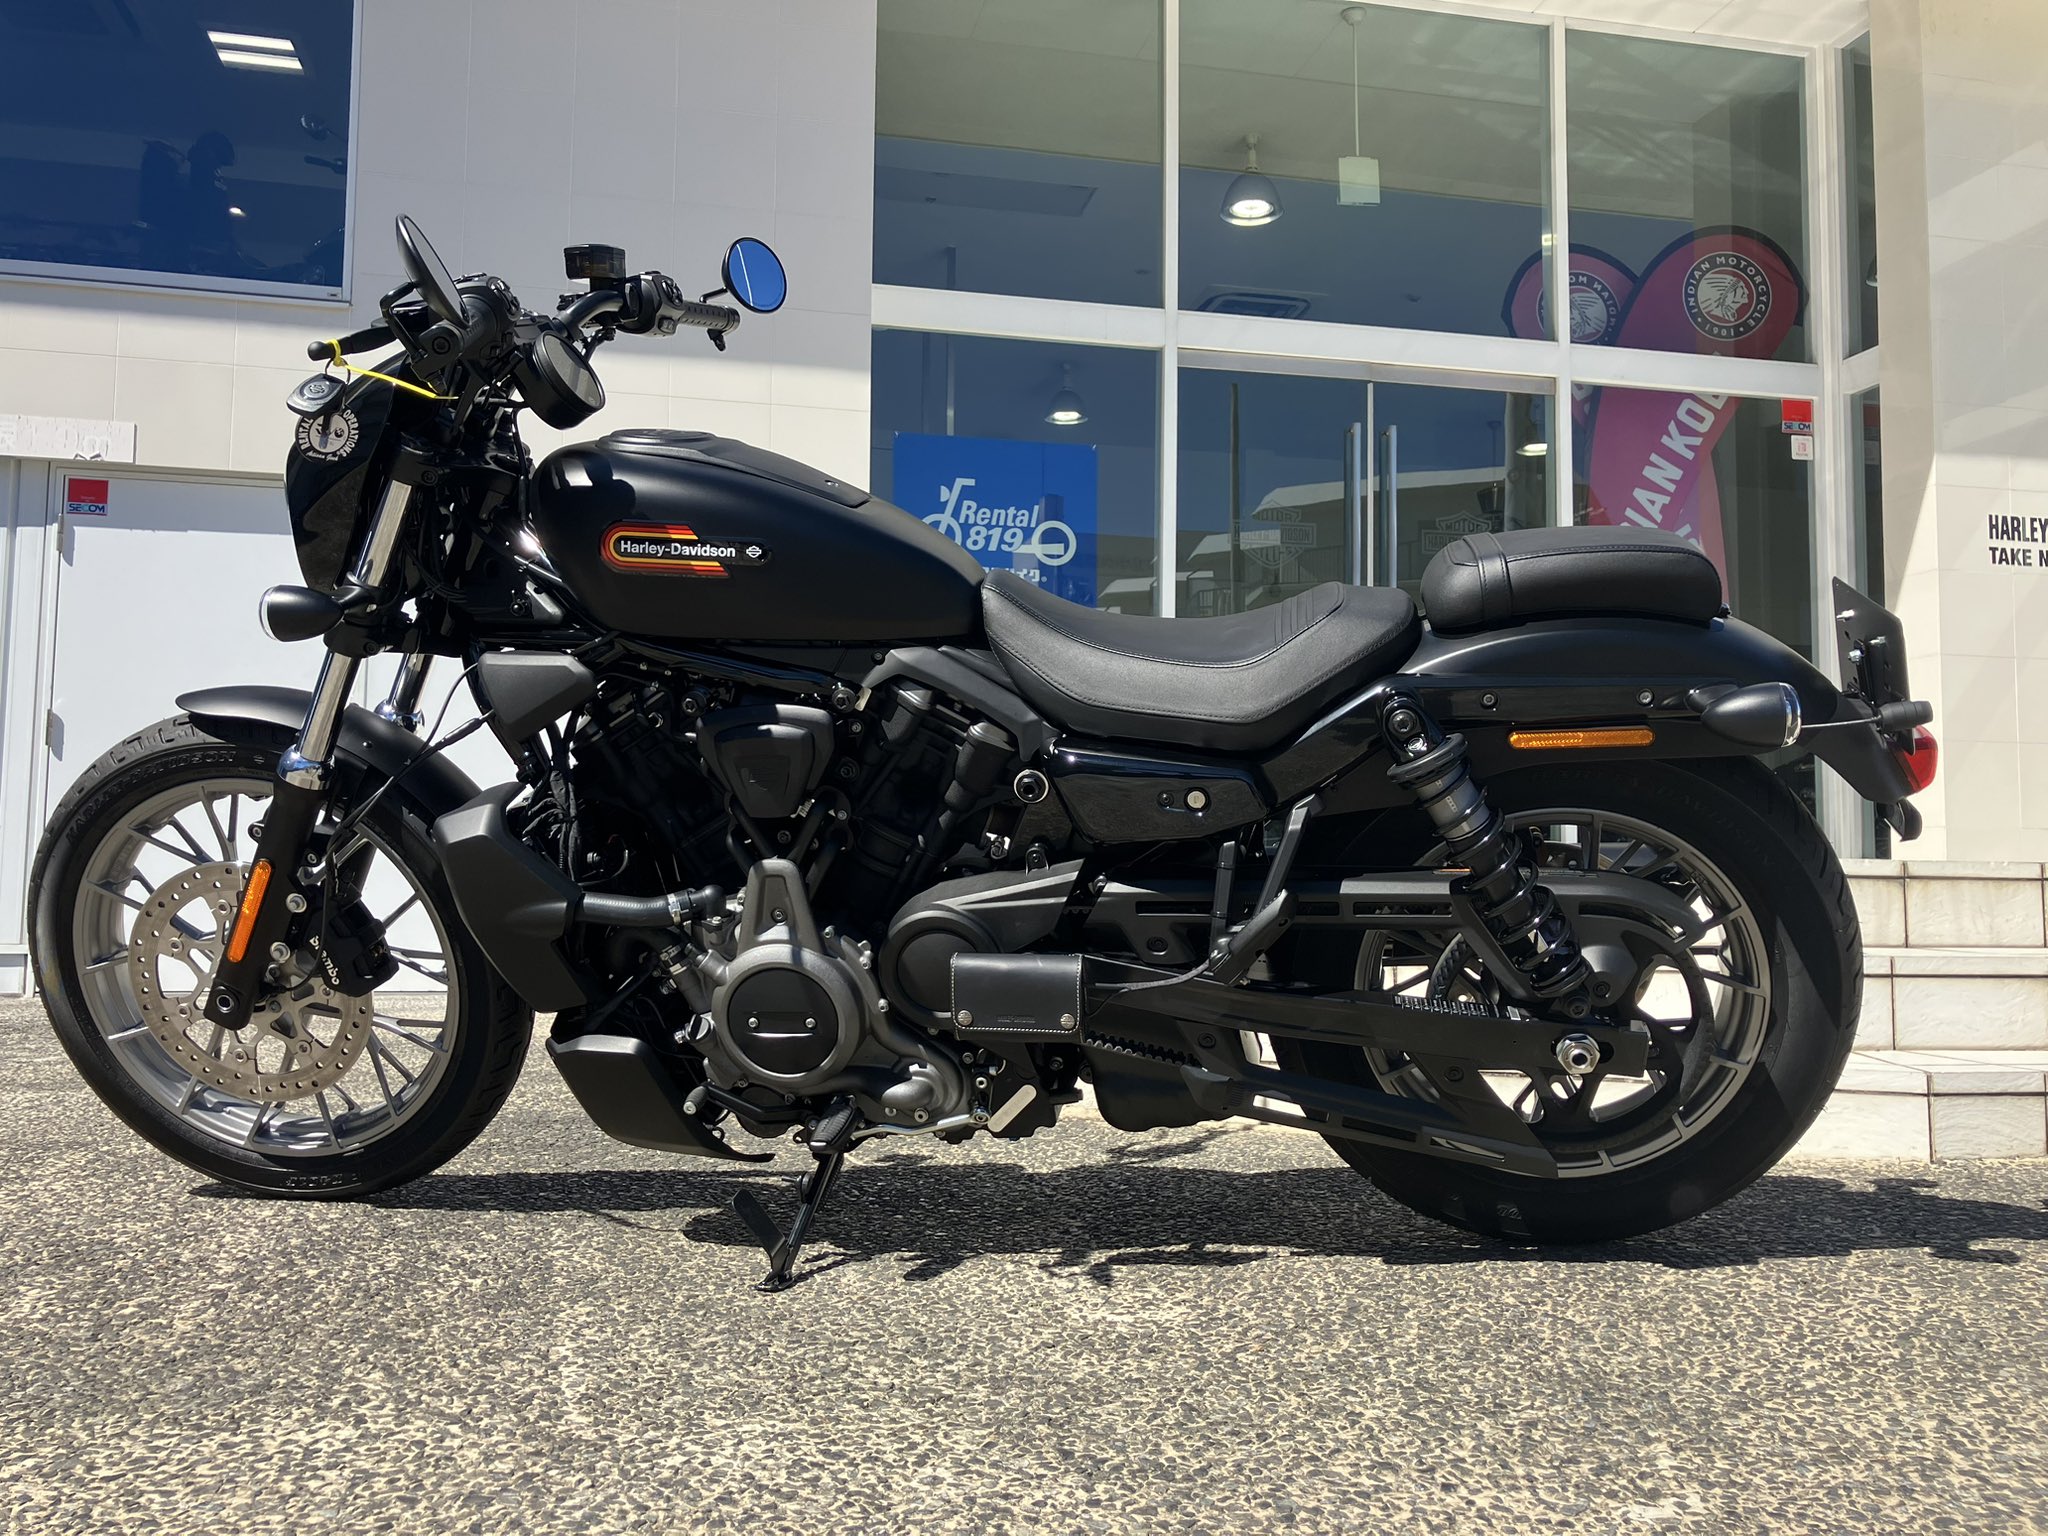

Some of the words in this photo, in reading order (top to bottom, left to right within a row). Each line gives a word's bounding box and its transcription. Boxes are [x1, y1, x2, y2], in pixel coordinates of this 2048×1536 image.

[1687, 261, 1710, 313] INDIAN
[1715, 256, 1767, 327] MOTORCYCLE
[298, 417, 314, 450] RENTAL
[1783, 422, 1811, 431] SECOM
[68, 503, 105, 513] SECOM
[959, 500, 1039, 528] Rental
[966, 525, 1024, 552] 819
[1988, 514, 2048, 543] HARLEY
[620, 540, 736, 558] Harley-Davidson
[1988, 546, 2032, 567] TAKE
